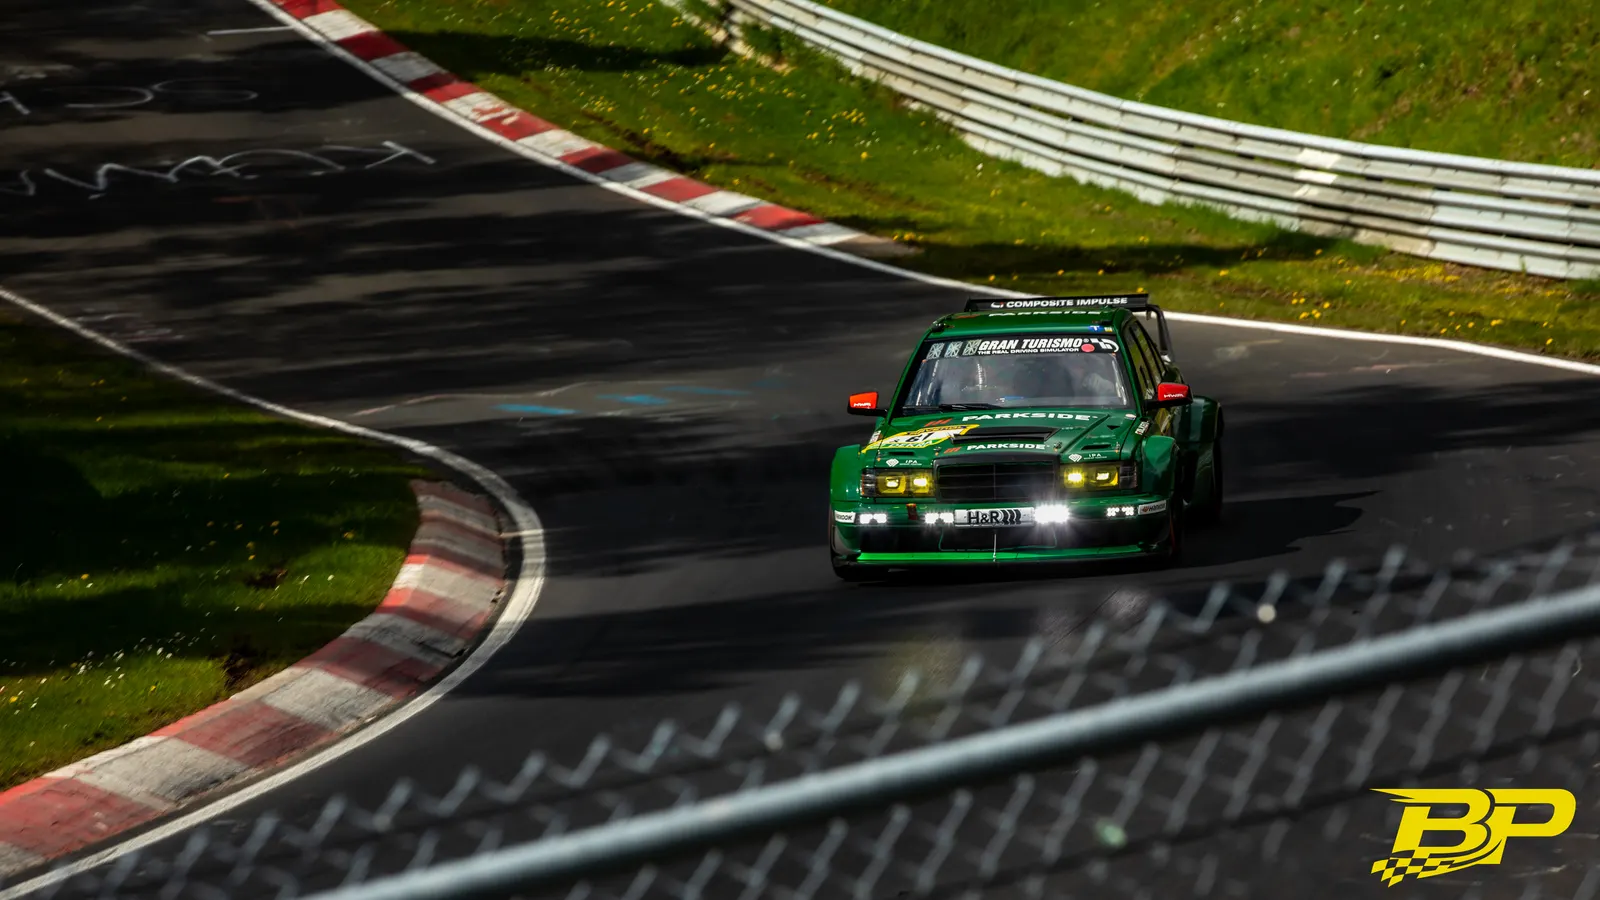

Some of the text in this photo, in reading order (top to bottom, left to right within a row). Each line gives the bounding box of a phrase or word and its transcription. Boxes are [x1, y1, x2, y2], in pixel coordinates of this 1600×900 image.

[1005, 297, 1128, 308] COMPOSITE IMPULSE
[978, 339, 1019, 351] GRAN
[962, 412, 1091, 421] PARKSIDE
[967, 510, 1000, 524] H&R
